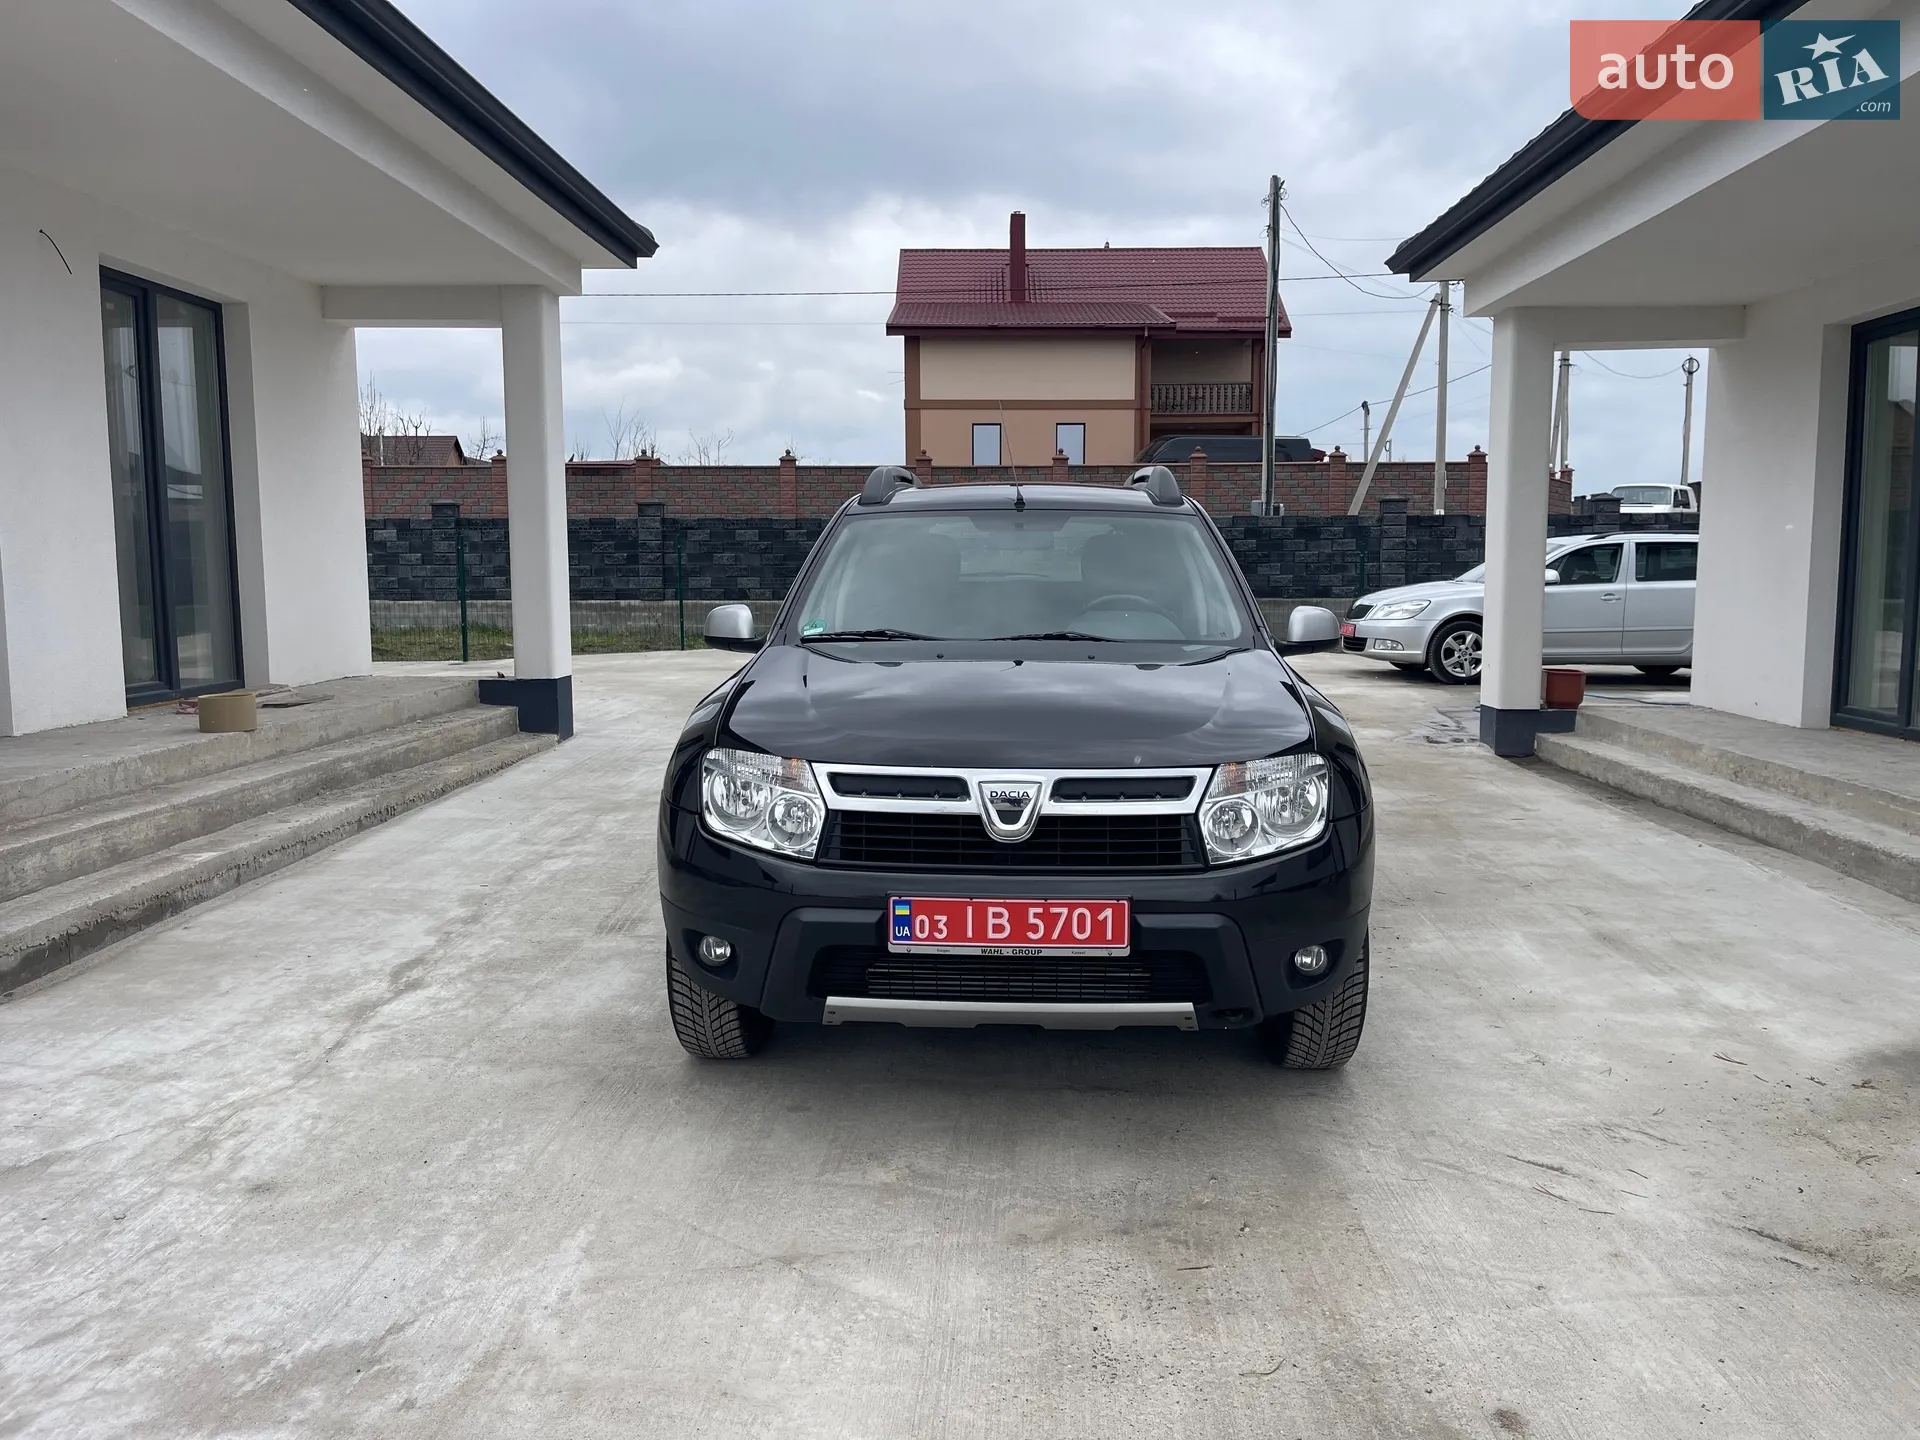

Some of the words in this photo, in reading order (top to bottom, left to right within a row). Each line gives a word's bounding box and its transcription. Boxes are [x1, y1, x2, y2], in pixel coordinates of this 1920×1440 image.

[990, 790, 1030, 798] DACIA
[914, 914, 948, 940] 03
[1026, 907, 1113, 941] 5701
[895, 926, 911, 937] UA
